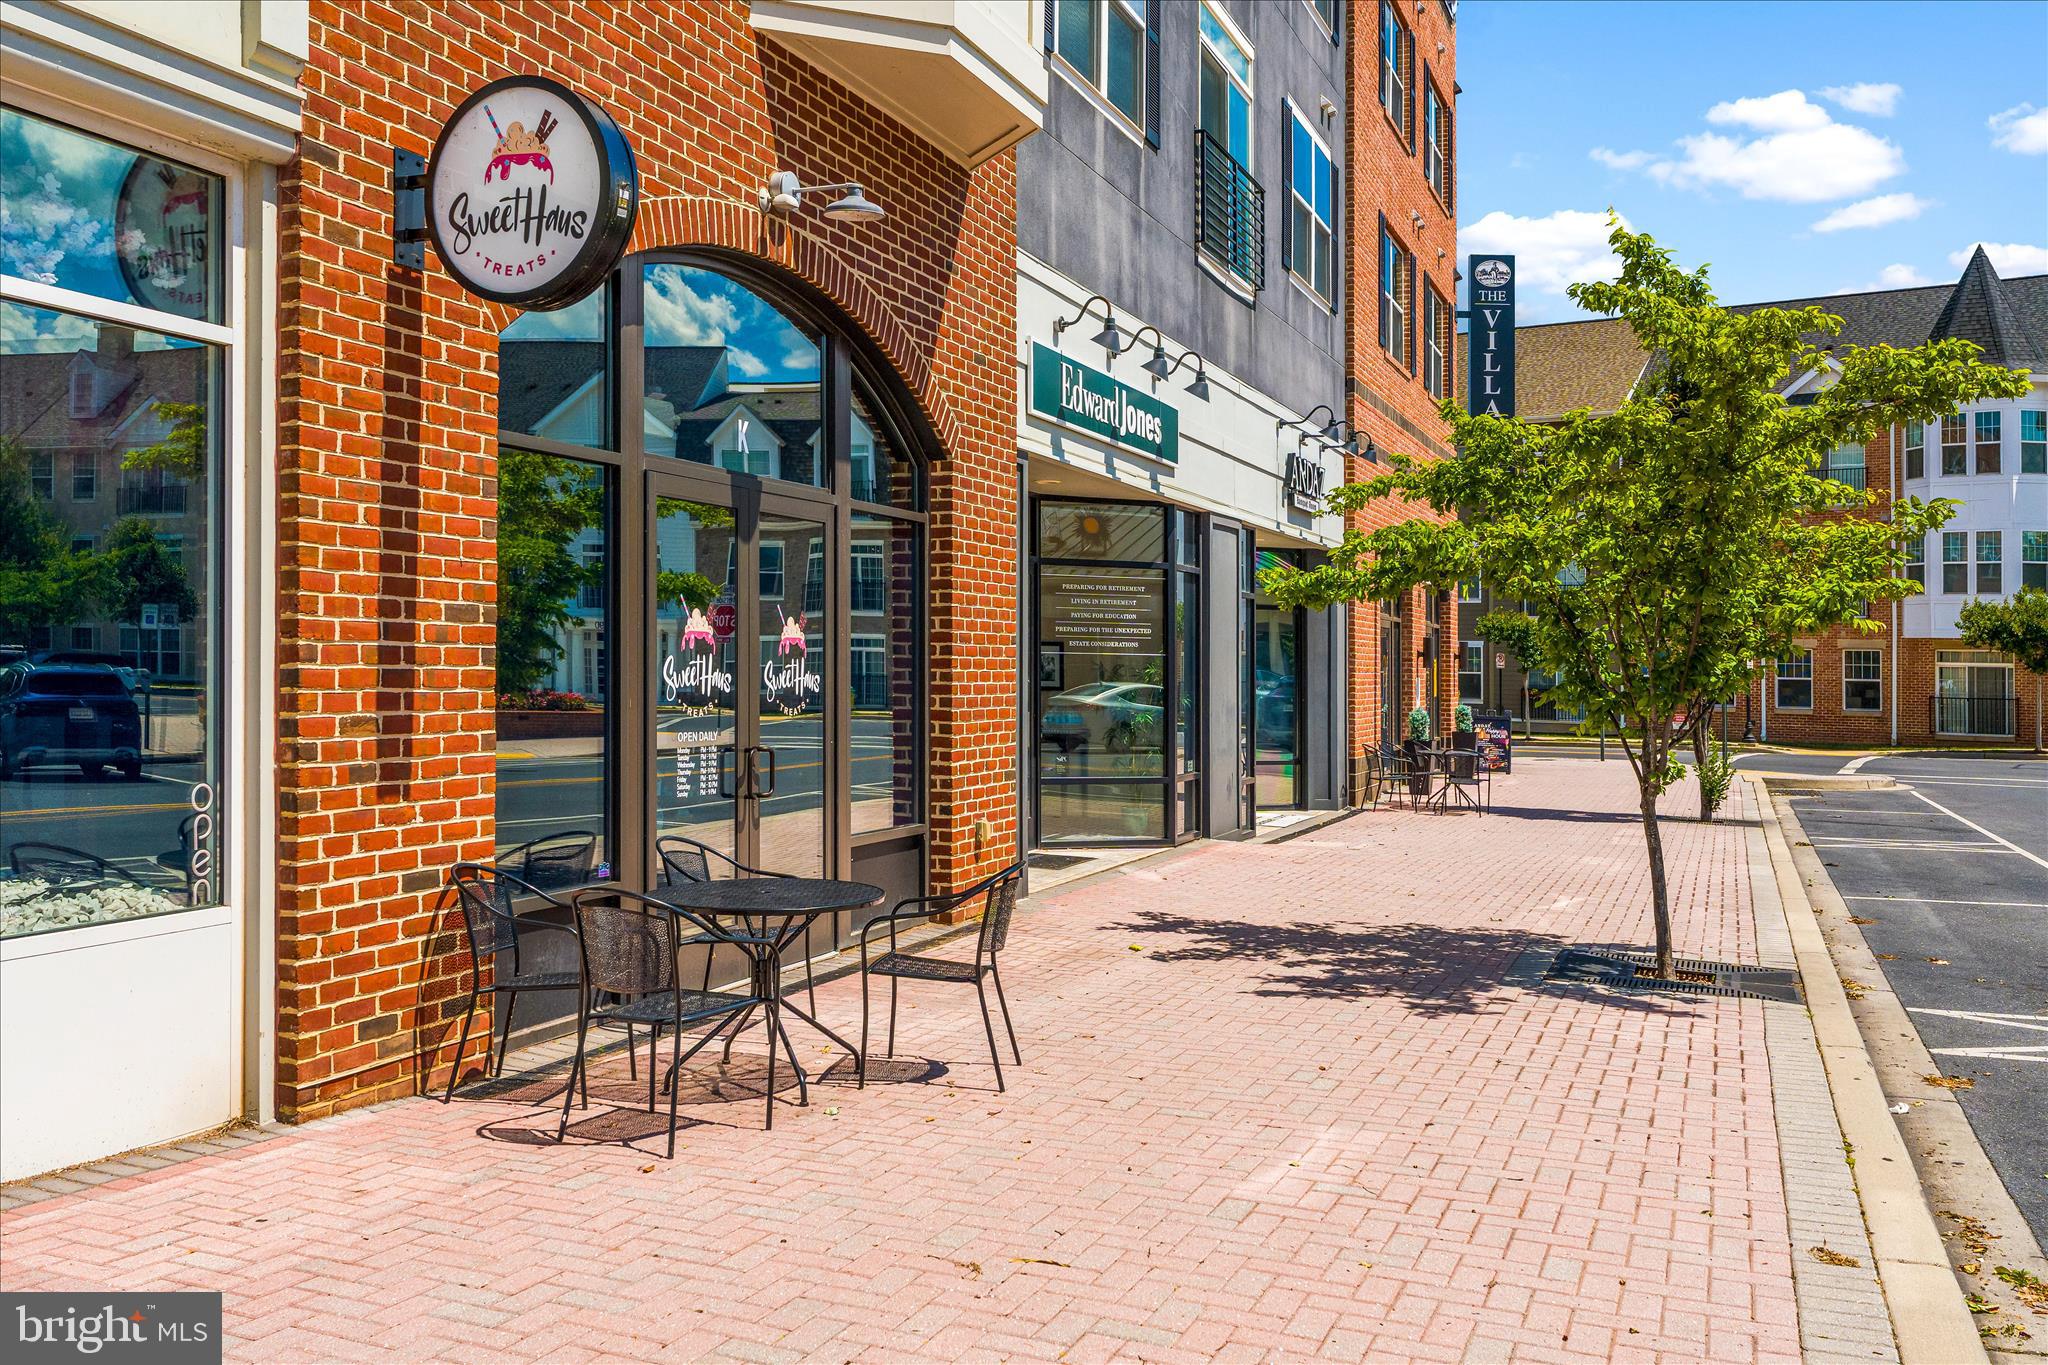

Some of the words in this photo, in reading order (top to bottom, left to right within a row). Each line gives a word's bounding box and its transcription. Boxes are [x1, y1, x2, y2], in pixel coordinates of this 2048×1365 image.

[483, 254, 547, 277] TREATS
[1479, 290, 1507, 301] THE
[1060, 361, 1120, 427] Edward
[1119, 390, 1163, 444] Jones
[738, 419, 749, 454] K
[682, 702, 714, 717] TREATS
[780, 702, 806, 716] TREATS
[677, 731, 698, 742] OPEN
[699, 731, 718, 741] DAILY
